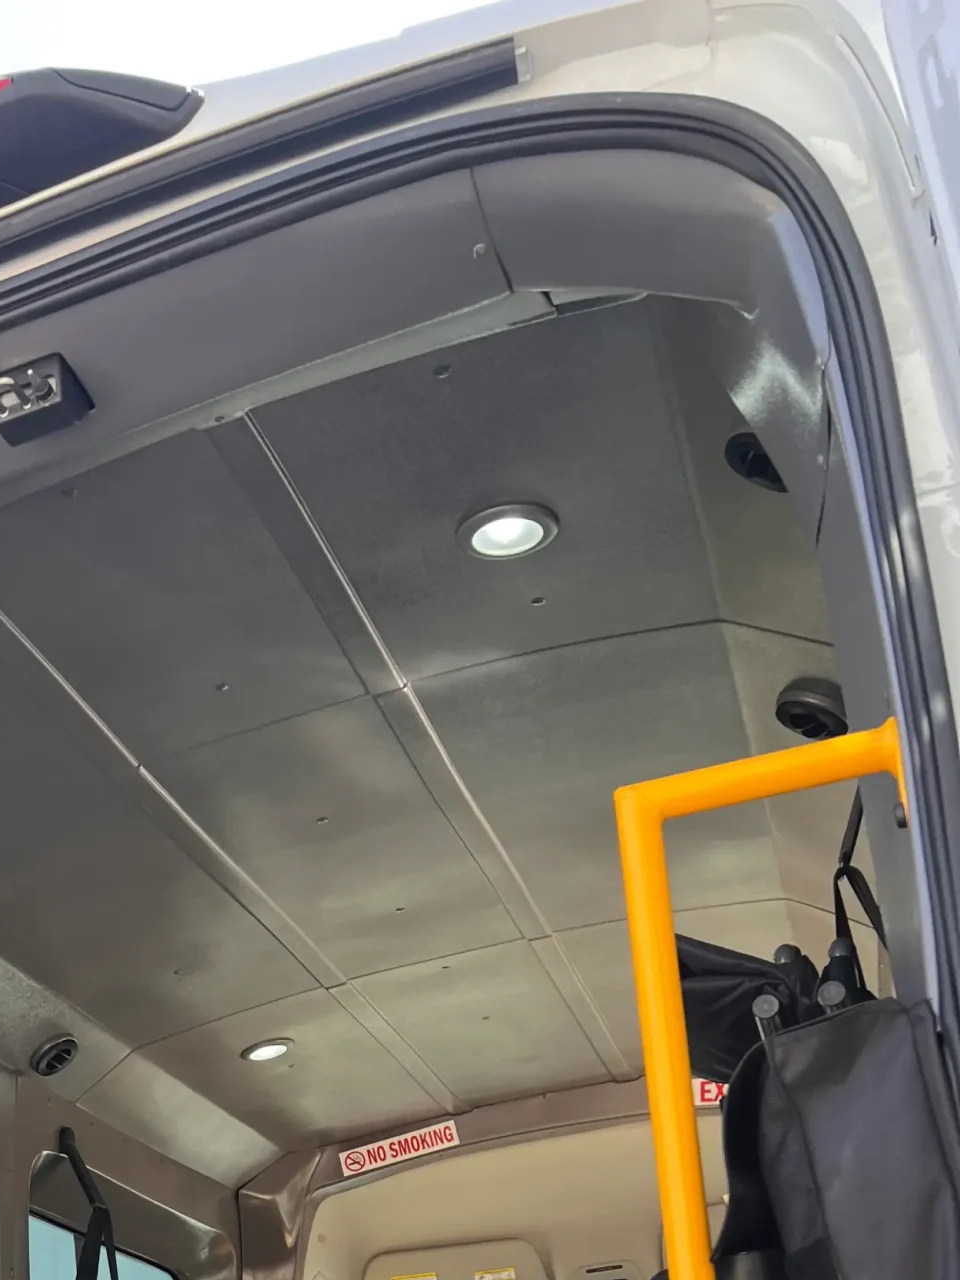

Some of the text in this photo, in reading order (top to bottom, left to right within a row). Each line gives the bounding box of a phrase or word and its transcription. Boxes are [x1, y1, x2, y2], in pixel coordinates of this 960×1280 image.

[701, 1081, 727, 1102] EX
[367, 1126, 454, 1165] NO SMOKING
